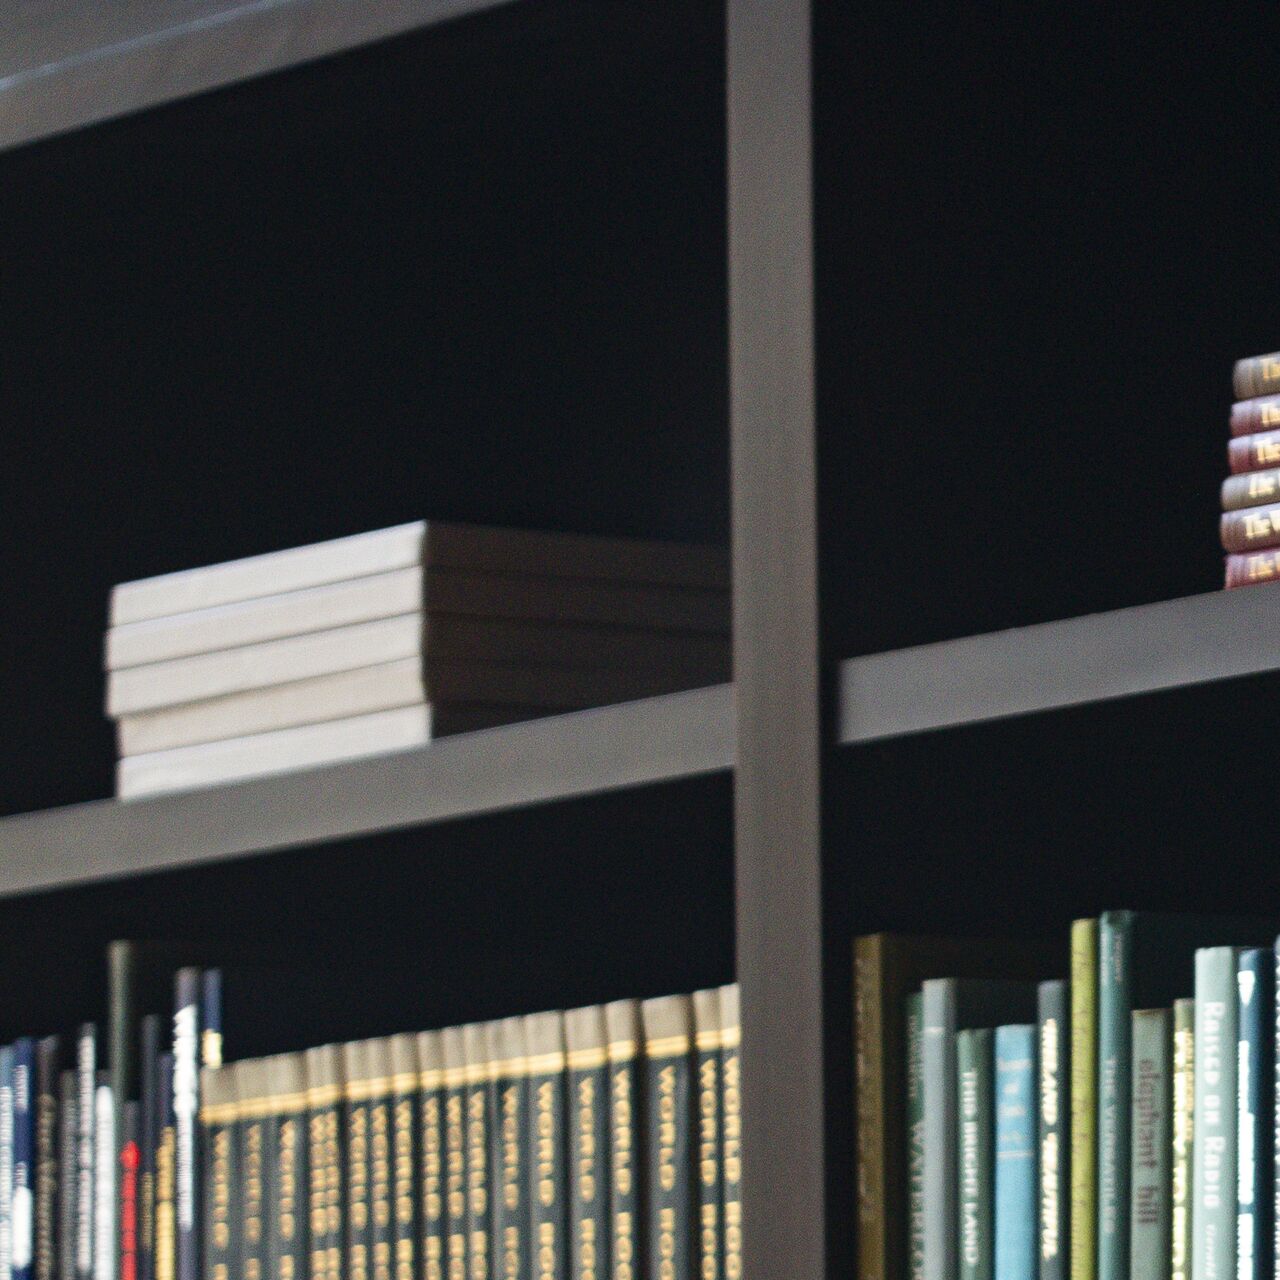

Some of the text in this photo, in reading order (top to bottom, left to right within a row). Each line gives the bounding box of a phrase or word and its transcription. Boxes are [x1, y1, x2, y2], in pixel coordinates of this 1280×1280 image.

[658, 1065, 677, 1192] WORLD
[1134, 1059, 1159, 1225] elephant hill
